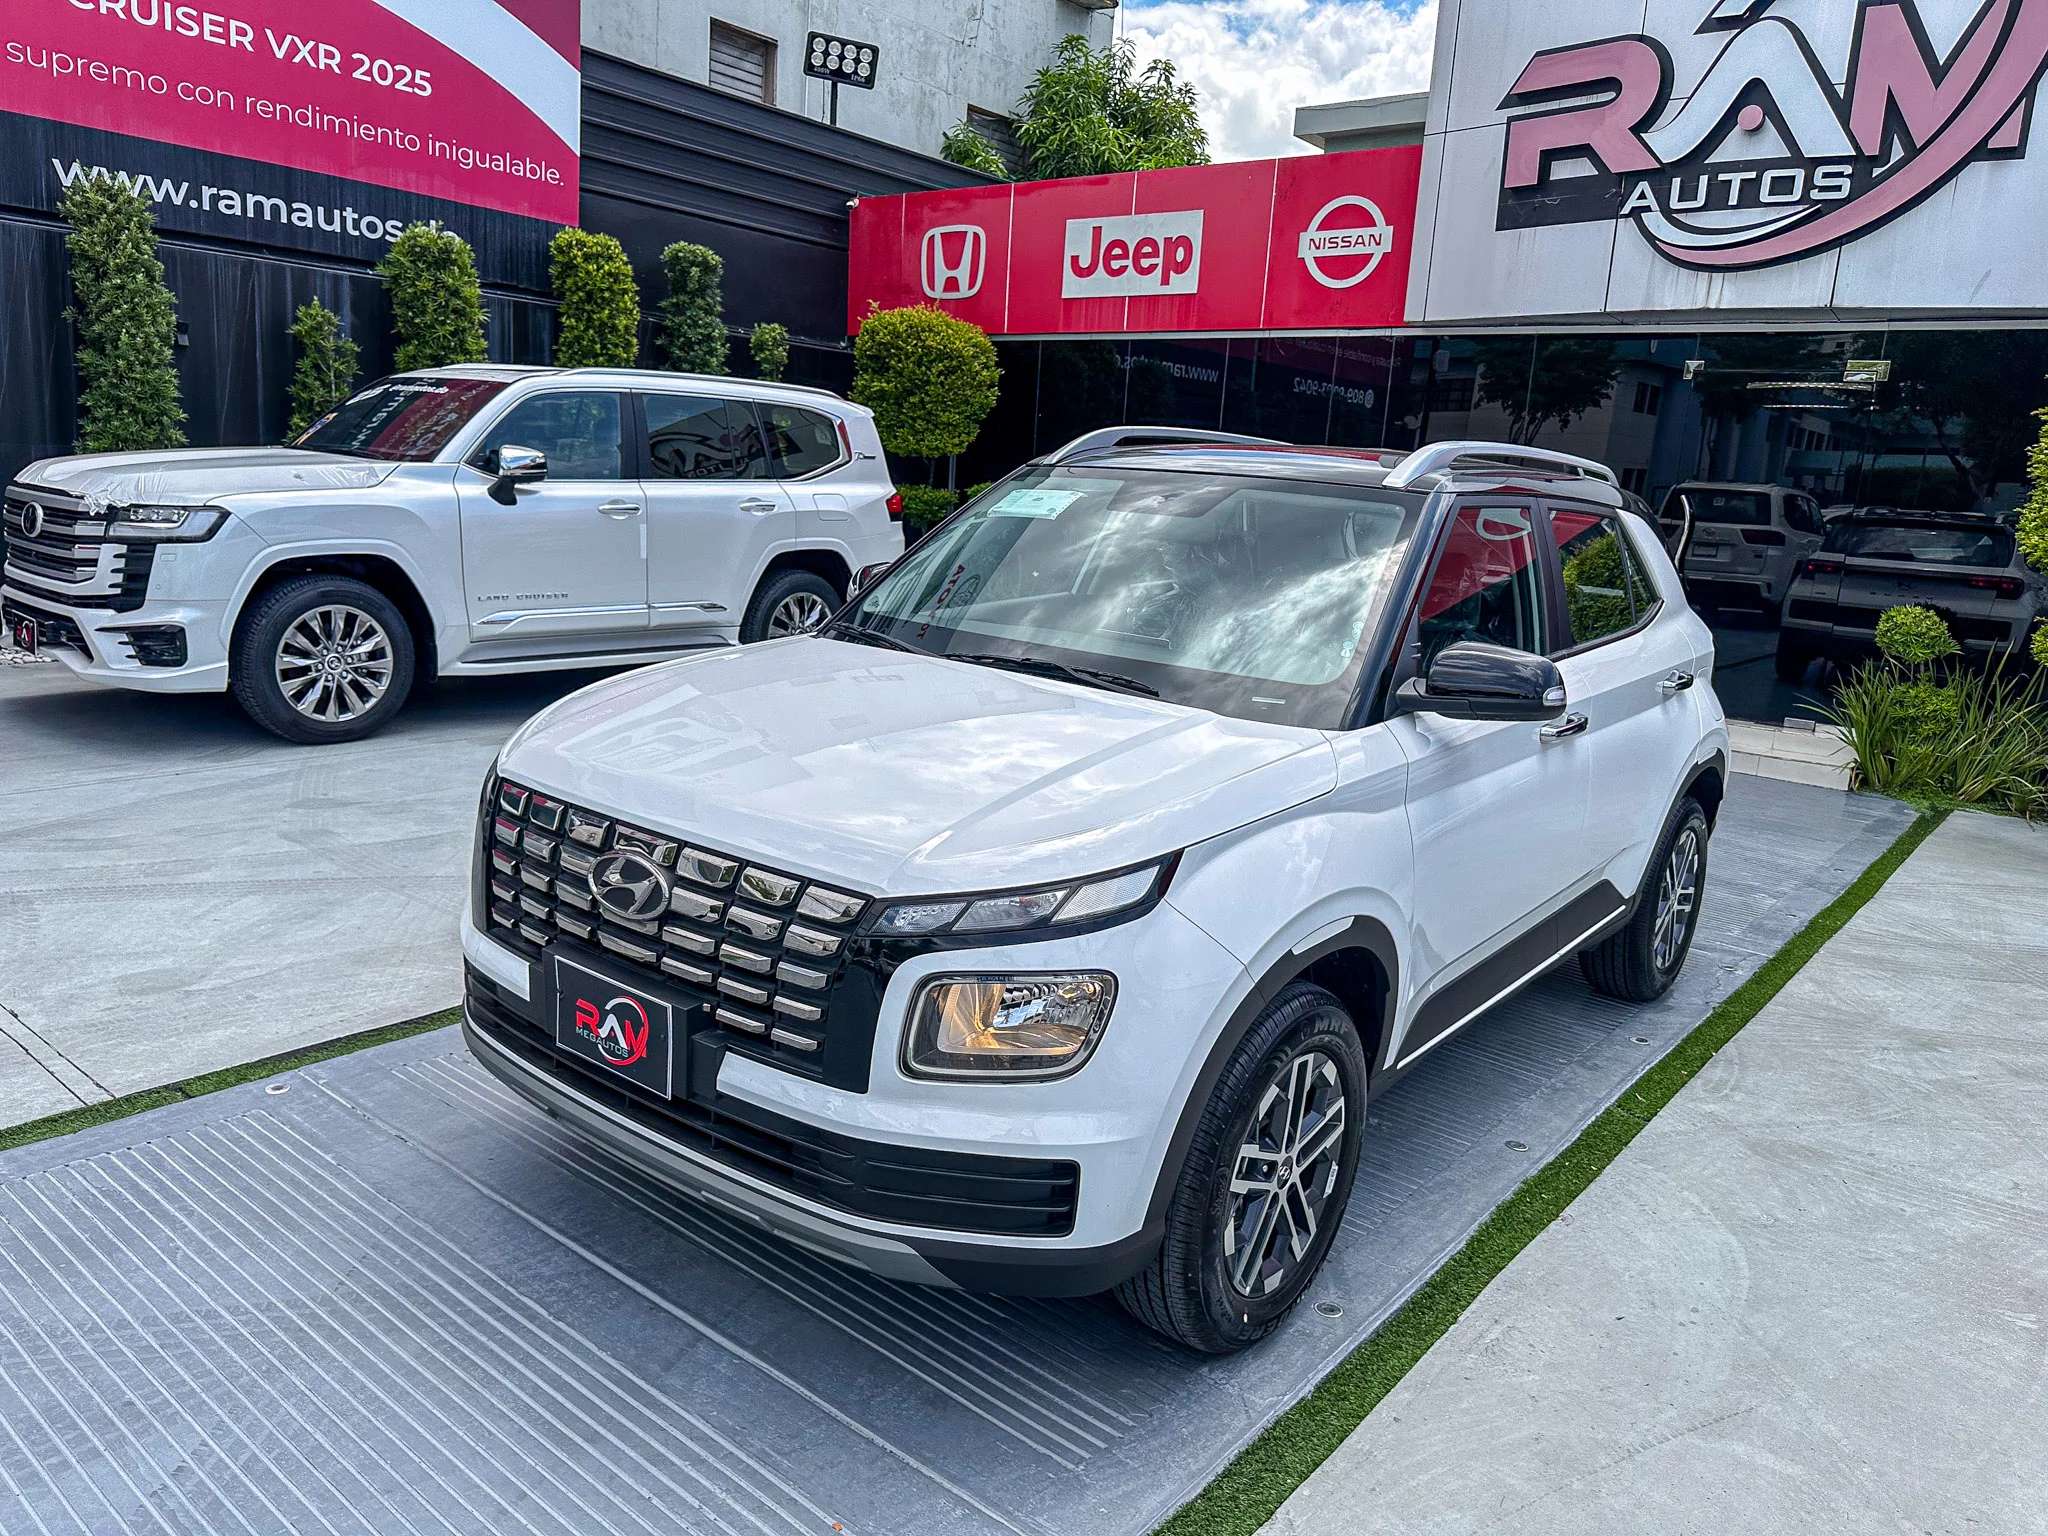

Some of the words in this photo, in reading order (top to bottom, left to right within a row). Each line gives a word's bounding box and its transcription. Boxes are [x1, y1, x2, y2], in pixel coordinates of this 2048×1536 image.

[264, 27, 342, 75] VXR
[351, 52, 433, 97] 2025
[1500, 0, 2046, 190] RAM
[5, 39, 168, 95] supremo
[177, 81, 235, 111] con
[245, 93, 420, 152] rendimiento
[427, 133, 565, 187] inigualable.
[1620, 164, 1853, 215] AUTOS
[1070, 225, 1194, 287] Jeep
[1308, 231, 1383, 252] NISSAN
